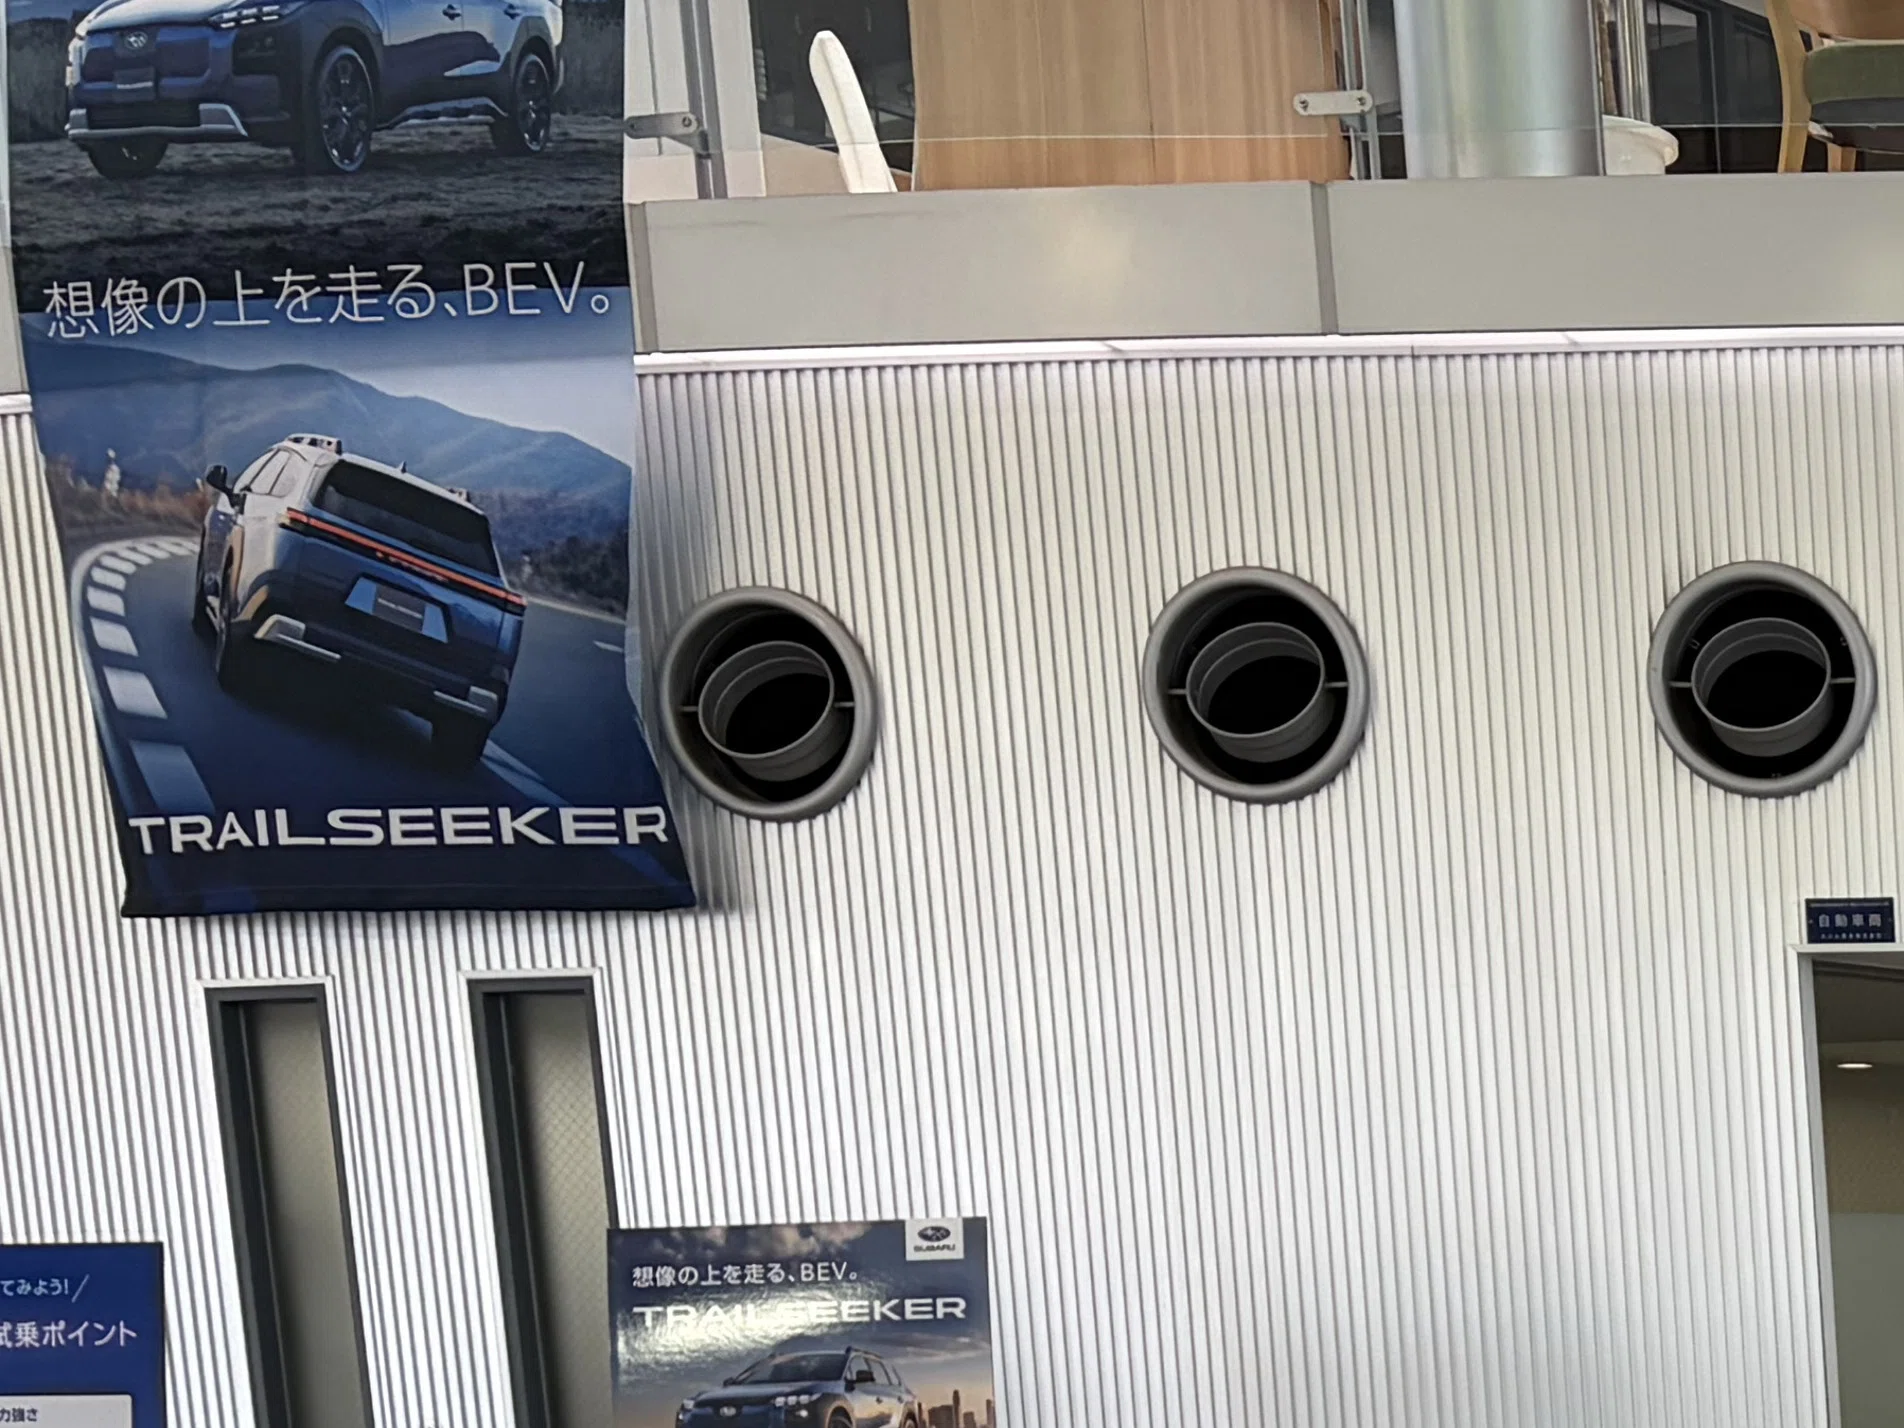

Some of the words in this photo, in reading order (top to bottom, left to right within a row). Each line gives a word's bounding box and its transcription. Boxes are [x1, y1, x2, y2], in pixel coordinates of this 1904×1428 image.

[45, 261, 612, 338] 想像の上を走る、BEV。
[129, 805, 671, 855] TRAILSEEKER
[913, 1243, 957, 1254] SUBARU
[632, 1261, 860, 1288] 想像の上を走る、BEV。
[632, 1297, 968, 1330] TRAILSEEKER
